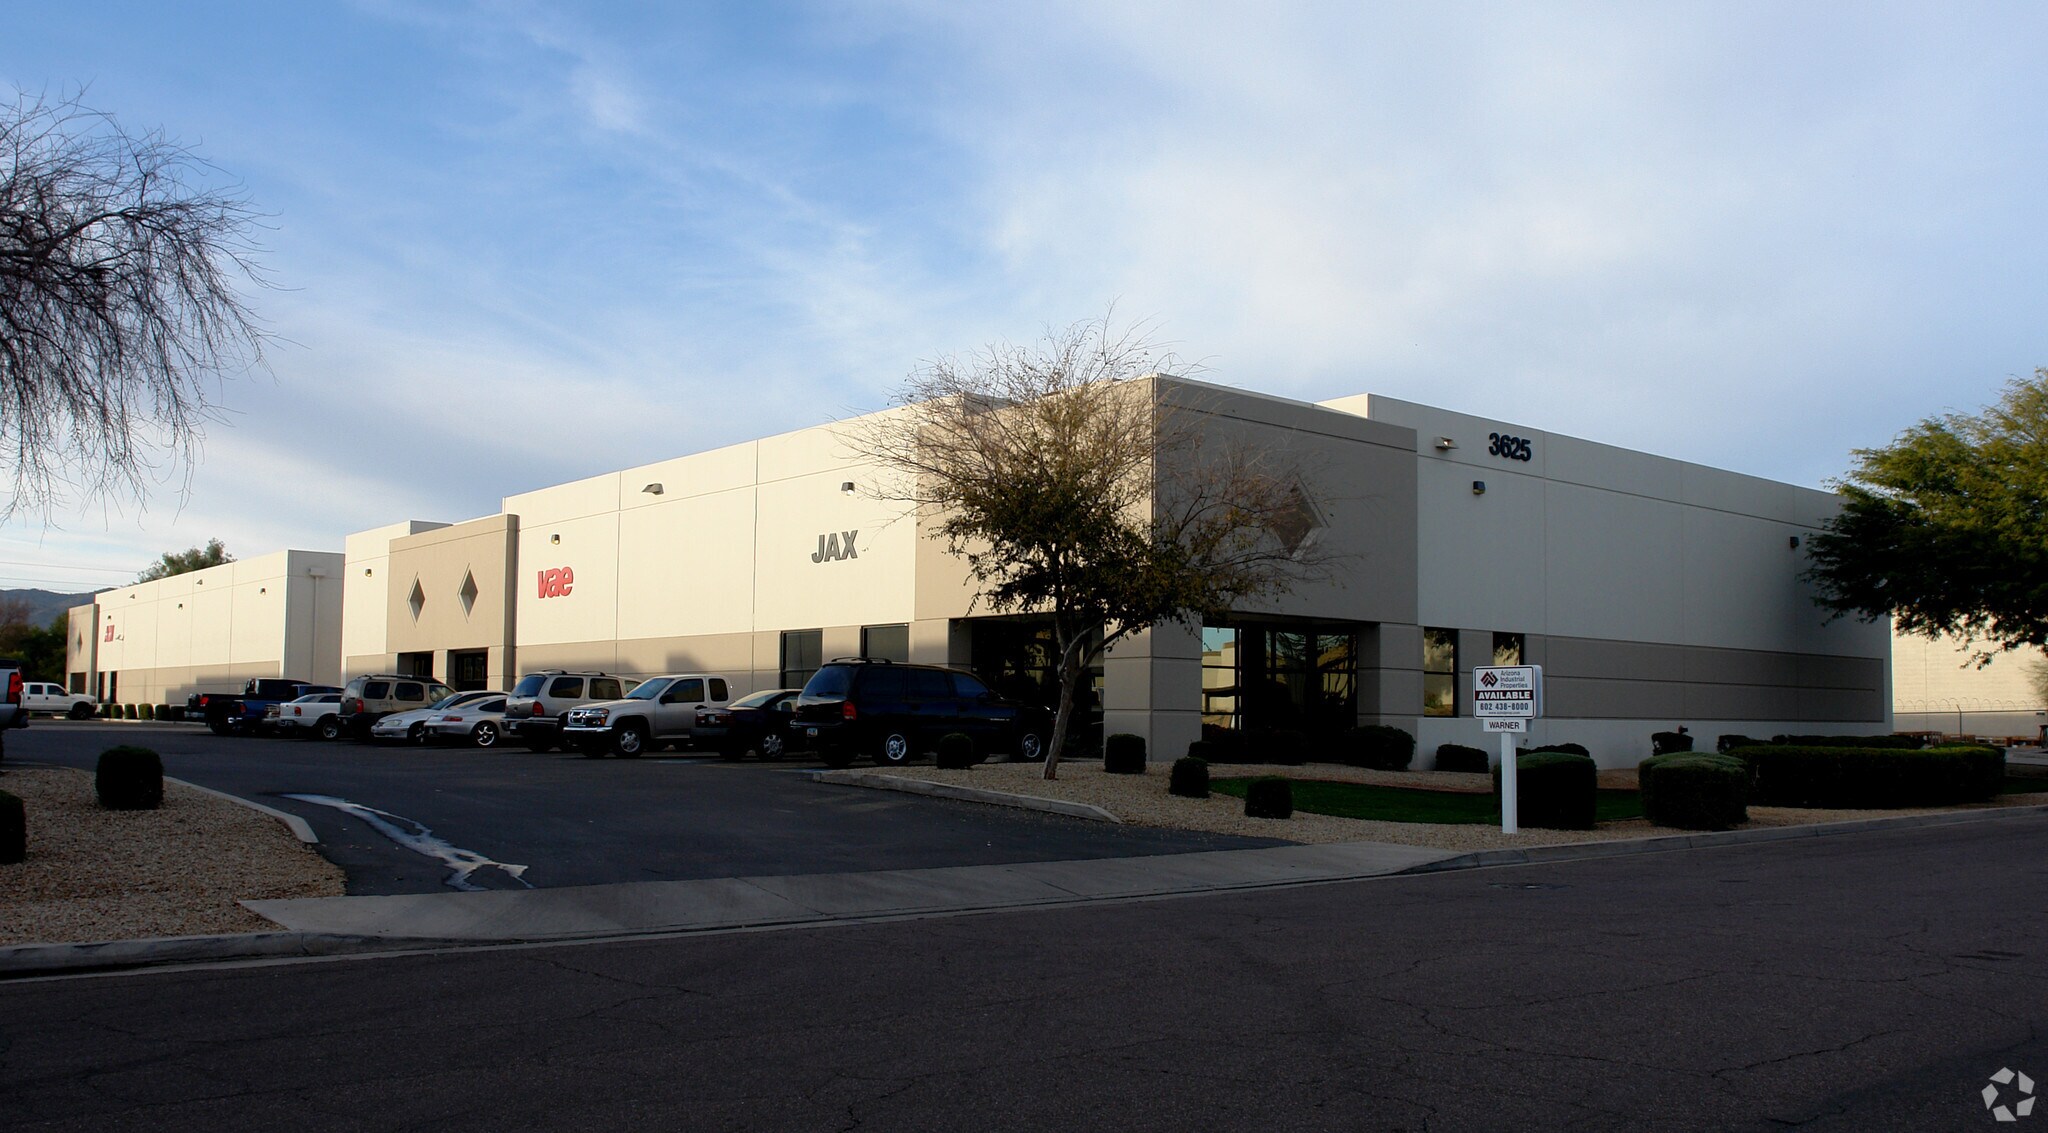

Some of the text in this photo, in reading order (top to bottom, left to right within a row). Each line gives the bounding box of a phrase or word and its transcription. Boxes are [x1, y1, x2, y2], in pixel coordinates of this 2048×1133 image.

[1489, 432, 1532, 462] 3625
[811, 529, 858, 563] JAX
[538, 566, 574, 599] vae
[1478, 691, 1531, 700] AVAILABLE
[1489, 721, 1520, 729] WARNER
